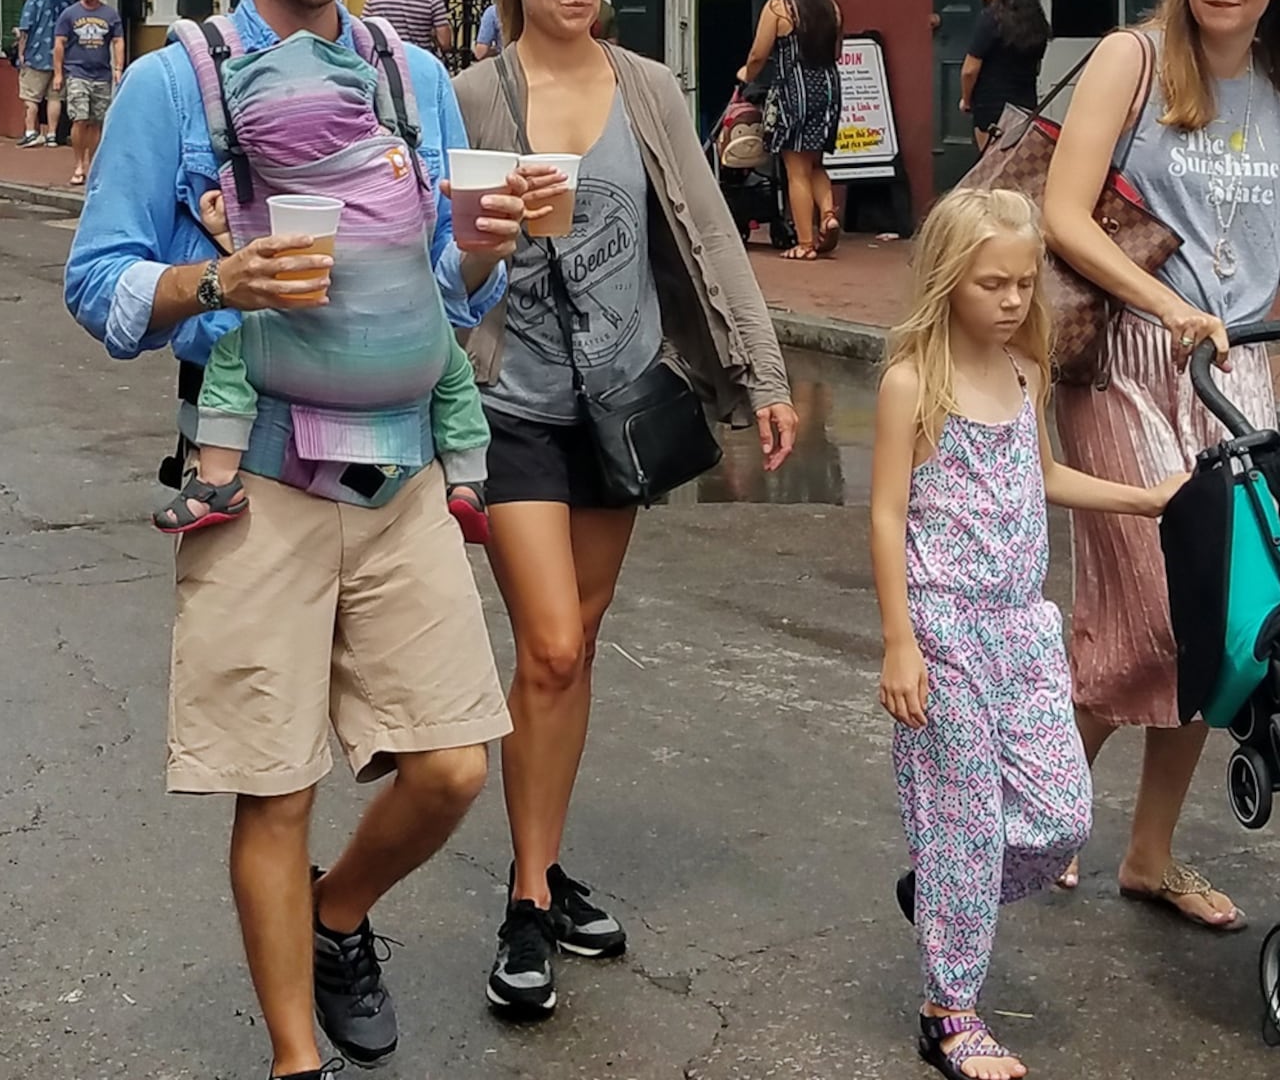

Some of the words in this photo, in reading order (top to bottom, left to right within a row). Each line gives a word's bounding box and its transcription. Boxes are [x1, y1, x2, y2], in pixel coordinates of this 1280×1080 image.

[1179, 126, 1225, 154] The
[1168, 146, 1280, 178] Sunshine
[1206, 176, 1274, 206] State
[568, 227, 631, 283] Beach
